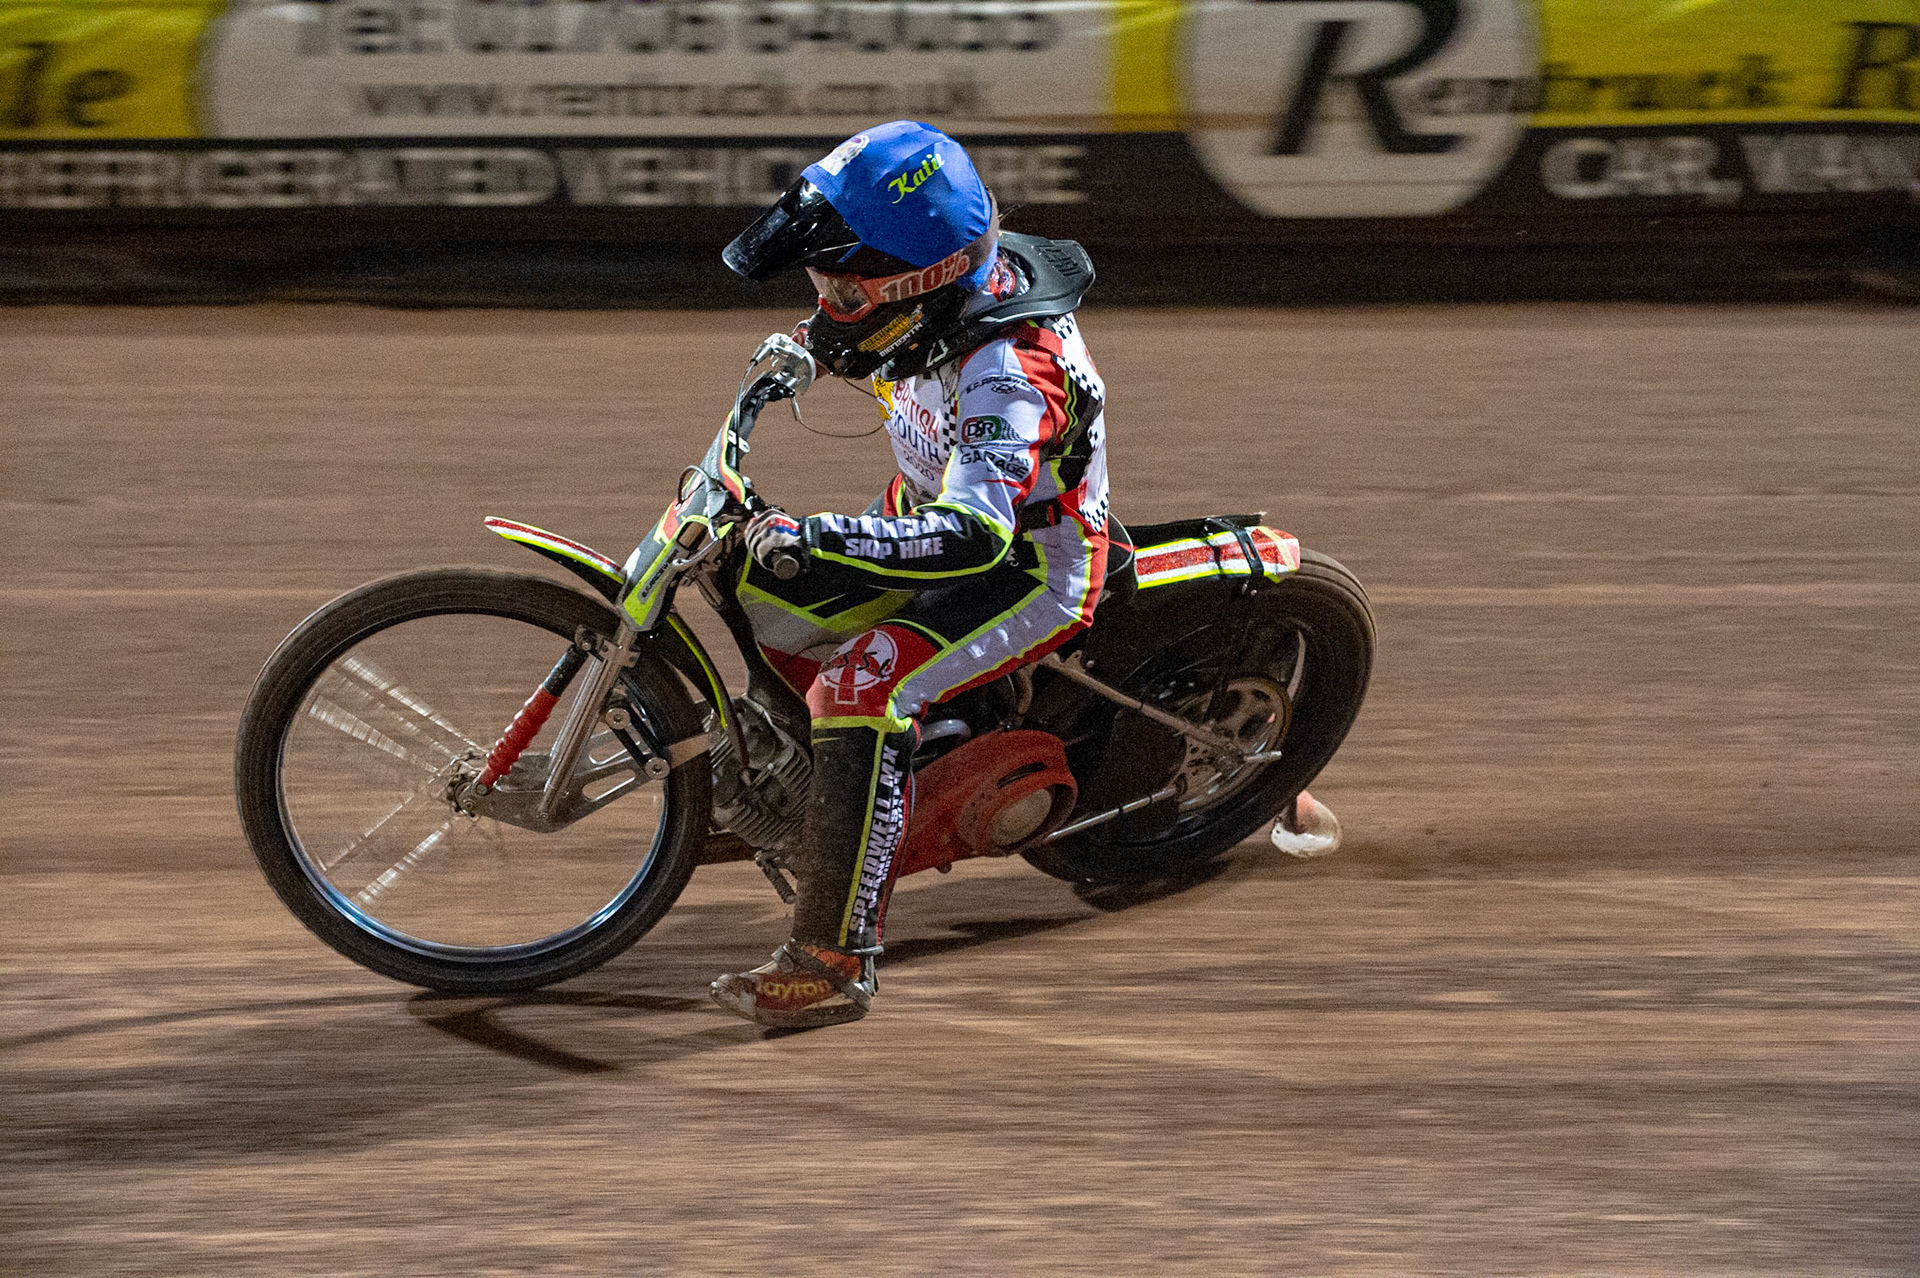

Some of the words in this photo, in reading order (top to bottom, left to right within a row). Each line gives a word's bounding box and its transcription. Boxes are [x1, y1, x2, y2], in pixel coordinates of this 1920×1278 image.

[879, 247, 970, 304] 100%
[845, 538, 893, 560] SKIP
[899, 536, 944, 560] HIRE
[849, 795, 892, 932] SPEEDWELL
[879, 744, 900, 788] MX
